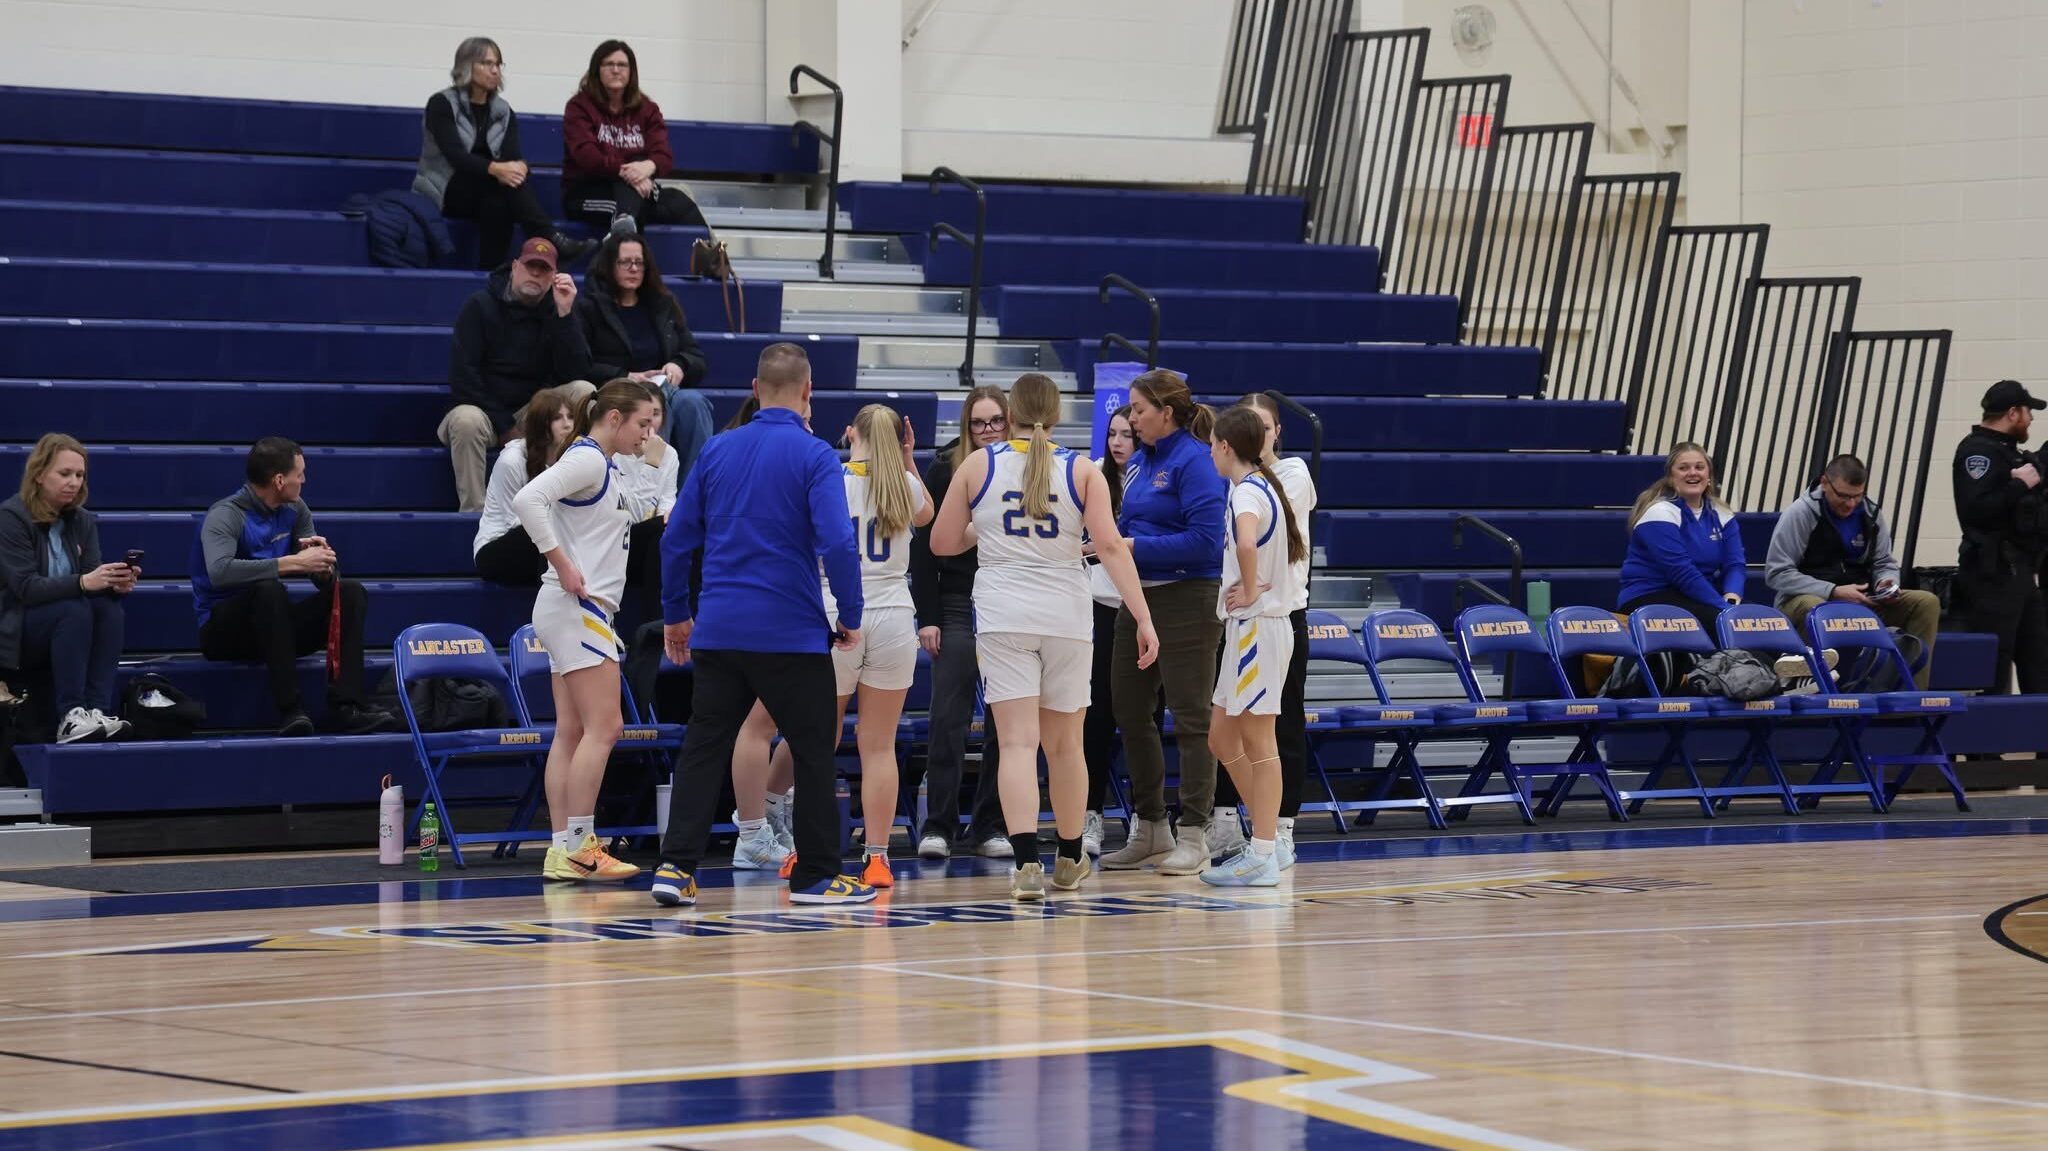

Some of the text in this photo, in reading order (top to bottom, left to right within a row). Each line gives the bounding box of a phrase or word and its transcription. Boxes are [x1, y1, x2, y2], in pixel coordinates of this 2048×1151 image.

[1002, 490, 1059, 539] 25
[1307, 624, 1350, 639] CASTER
[1375, 623, 1438, 639] LANCASTER
[1470, 620, 1531, 637] LANCASTER
[1559, 620, 1621, 634] LANCASTER
[1641, 618, 1700, 632] LANCASTER
[1729, 617, 1789, 632] LANCASTER
[1823, 617, 1880, 632] LANCASTER
[408, 638, 486, 656] LANCASTER
[1566, 704, 1598, 715] ARROWS
[1658, 702, 1691, 713] ARROWS
[1827, 699, 1860, 710] ARROWS
[1920, 697, 1951, 708] ARROWS
[1380, 710, 1415, 721] ARROWS
[1475, 707, 1509, 718] ARROWS
[500, 732, 541, 745] ARROWS
